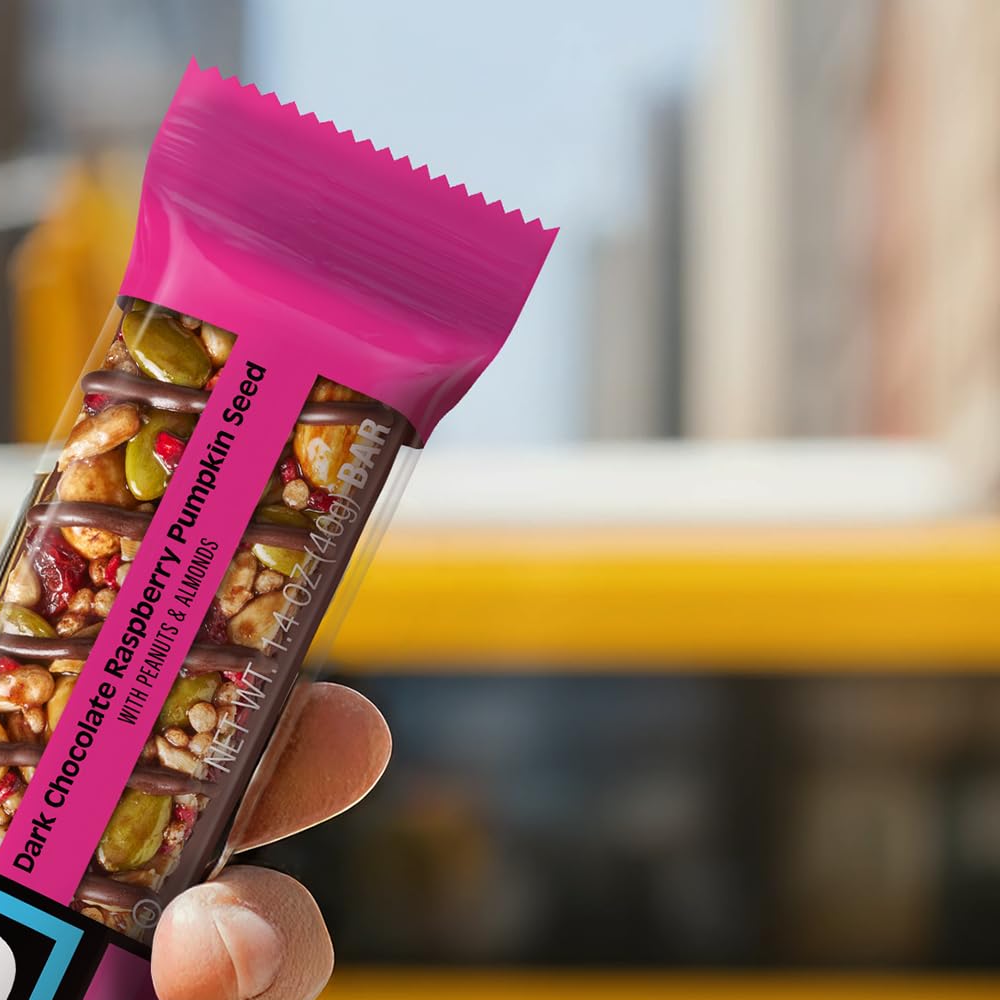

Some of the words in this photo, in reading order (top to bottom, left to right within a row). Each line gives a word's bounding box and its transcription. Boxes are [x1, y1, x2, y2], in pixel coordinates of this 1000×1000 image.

[174, 537, 219, 607] ALMONDS
[204, 712, 249, 773] NET
[261, 611, 300, 652] 1.4
[283, 562, 322, 607] OZ
[304, 493, 361, 564] (40g)
[337, 418, 391, 490] BAR
[13, 812, 57, 874] Dark
[44, 682, 117, 808] Chocolate
[104, 546, 182, 679] Raspberry
[167, 430, 235, 545] Pumpkin
[223, 361, 267, 426] Seed
[167, 608, 187, 622] &
[135, 622, 179, 687] PEANUTS
[117, 688, 149, 726] WITH
